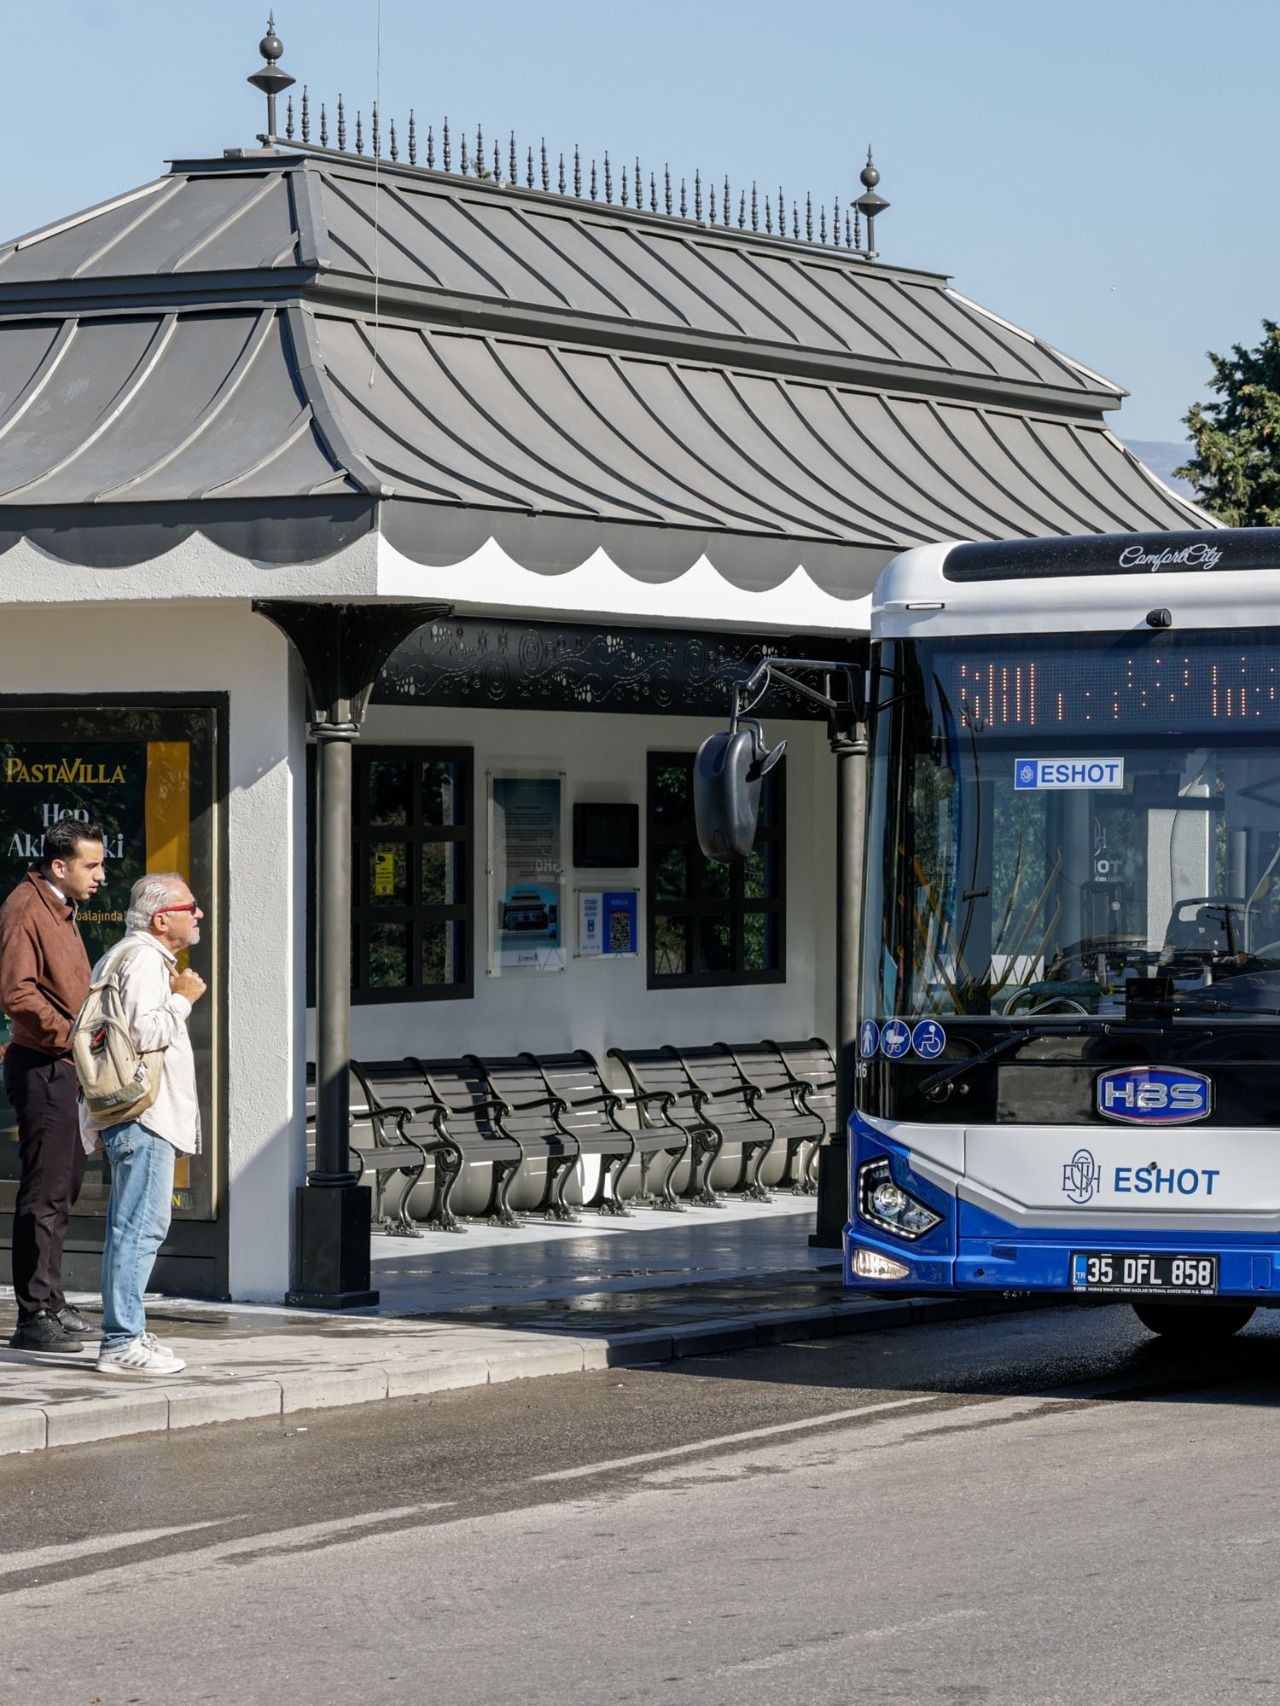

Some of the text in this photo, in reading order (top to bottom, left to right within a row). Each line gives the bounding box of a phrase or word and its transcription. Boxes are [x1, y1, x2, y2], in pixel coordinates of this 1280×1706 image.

[1041, 764, 1119, 783] ESHOT
[1114, 1167, 1220, 1195] ESHOT
[1087, 1258, 1113, 1283] 35
[1123, 1258, 1162, 1285] DFL
[1171, 1260, 1211, 1286] 858
